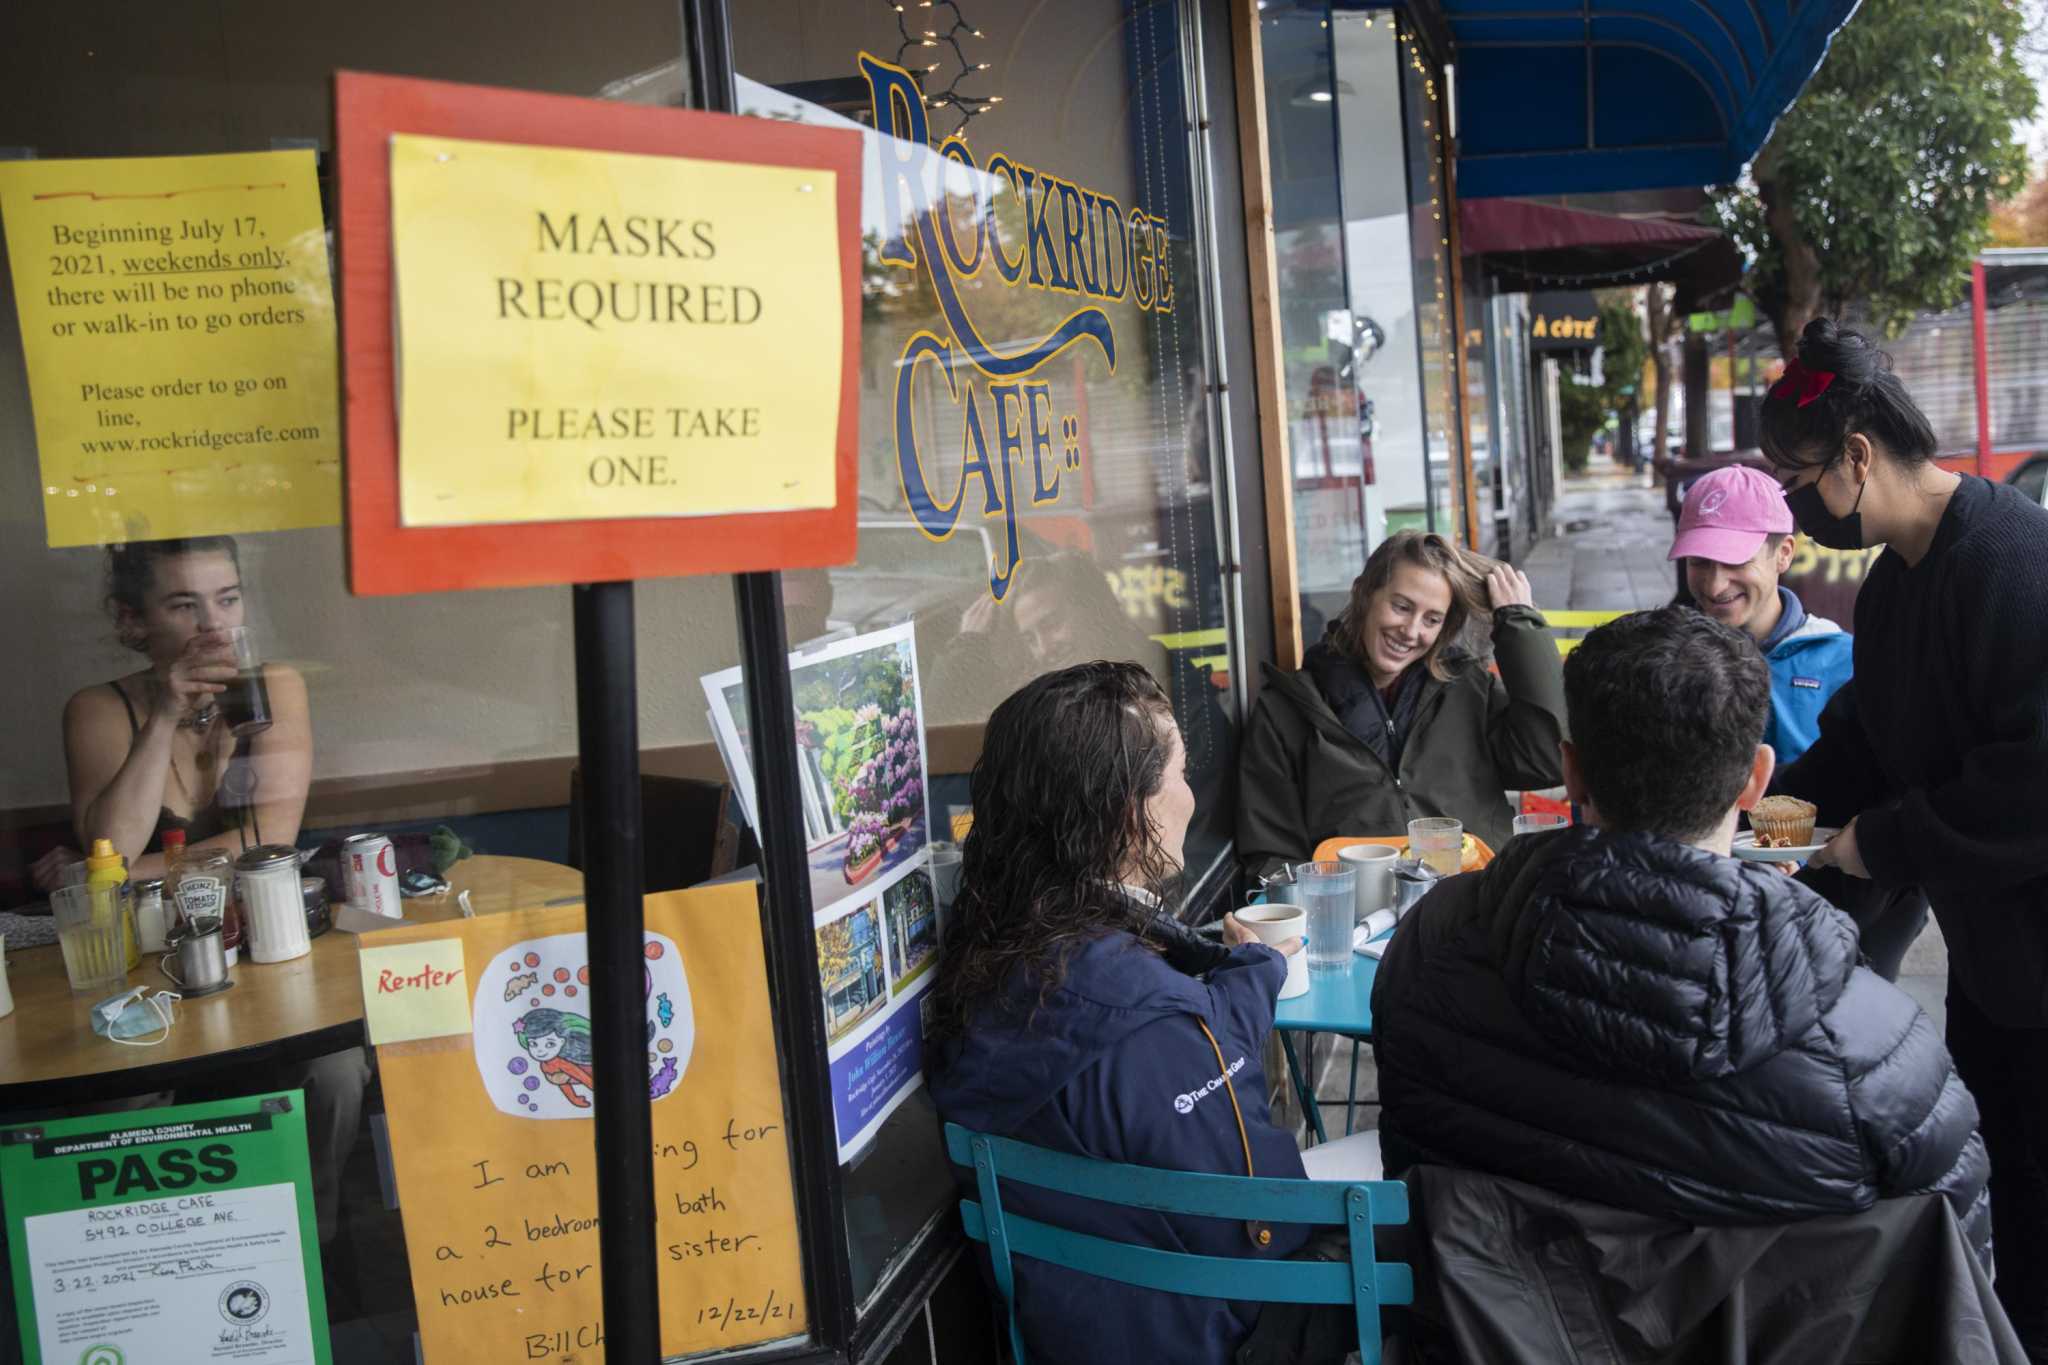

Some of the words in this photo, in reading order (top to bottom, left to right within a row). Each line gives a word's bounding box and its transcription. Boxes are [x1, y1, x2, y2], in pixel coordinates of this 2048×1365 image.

[857, 49, 1175, 380] ROCKRIDGE
[52, 223, 172, 249] Beginning
[179, 219, 224, 243] July
[233, 216, 266, 239] 17,
[536, 210, 717, 261] MASKS
[50, 254, 116, 277] 2021,
[123, 248, 232, 274] weekends
[239, 246, 291, 270] only,
[47, 286, 105, 307] there
[112, 281, 156, 304] will
[163, 281, 189, 302] be
[196, 282, 224, 300] no
[231, 276, 296, 303] phone
[495, 277, 763, 331] REQUIRED
[52, 319, 77, 338] or
[83, 311, 169, 334] walk-in
[176, 311, 198, 331] to
[205, 312, 232, 337] go
[239, 305, 305, 328] orders
[81, 382, 145, 402] Please
[151, 377, 204, 398] order
[209, 377, 229, 396] to
[233, 378, 258, 400] go
[263, 374, 288, 391] on
[98, 409, 141, 428] line,
[506, 408, 655, 441] PLEASE
[666, 407, 761, 438] TAKE
[81, 425, 320, 456] www.rockridgecafe.com
[588, 456, 677, 488] ONE.
[894, 330, 1061, 603] CAFE
[378, 964, 464, 994] Renter
[54, 1139, 119, 1154] DEPARTMENT
[120, 1137, 133, 1146] OF
[135, 1128, 213, 1144] ENVIRONMENTAL
[215, 1123, 252, 1135] HEALTH
[110, 1128, 153, 1141] ALAMEDA
[156, 1123, 195, 1137] COUNTY
[473, 1160, 504, 1189] I
[526, 1161, 570, 1179] am
[722, 1118, 778, 1150] for
[77, 1143, 238, 1200] PASS
[88, 1202, 170, 1222] ROCKRIDGE
[177, 1194, 215, 1210] CAFE
[436, 1246, 463, 1261] a
[485, 1225, 512, 1248] 2
[675, 1187, 726, 1215] bath
[85, 1225, 130, 1242] 5492
[136, 1216, 206, 1234] COLLEGE
[440, 1279, 521, 1306] house
[535, 1262, 593, 1292] for
[669, 1230, 762, 1261] sister.
[698, 1289, 794, 1331] 12/22/21
[526, 1331, 570, 1359] Bill
